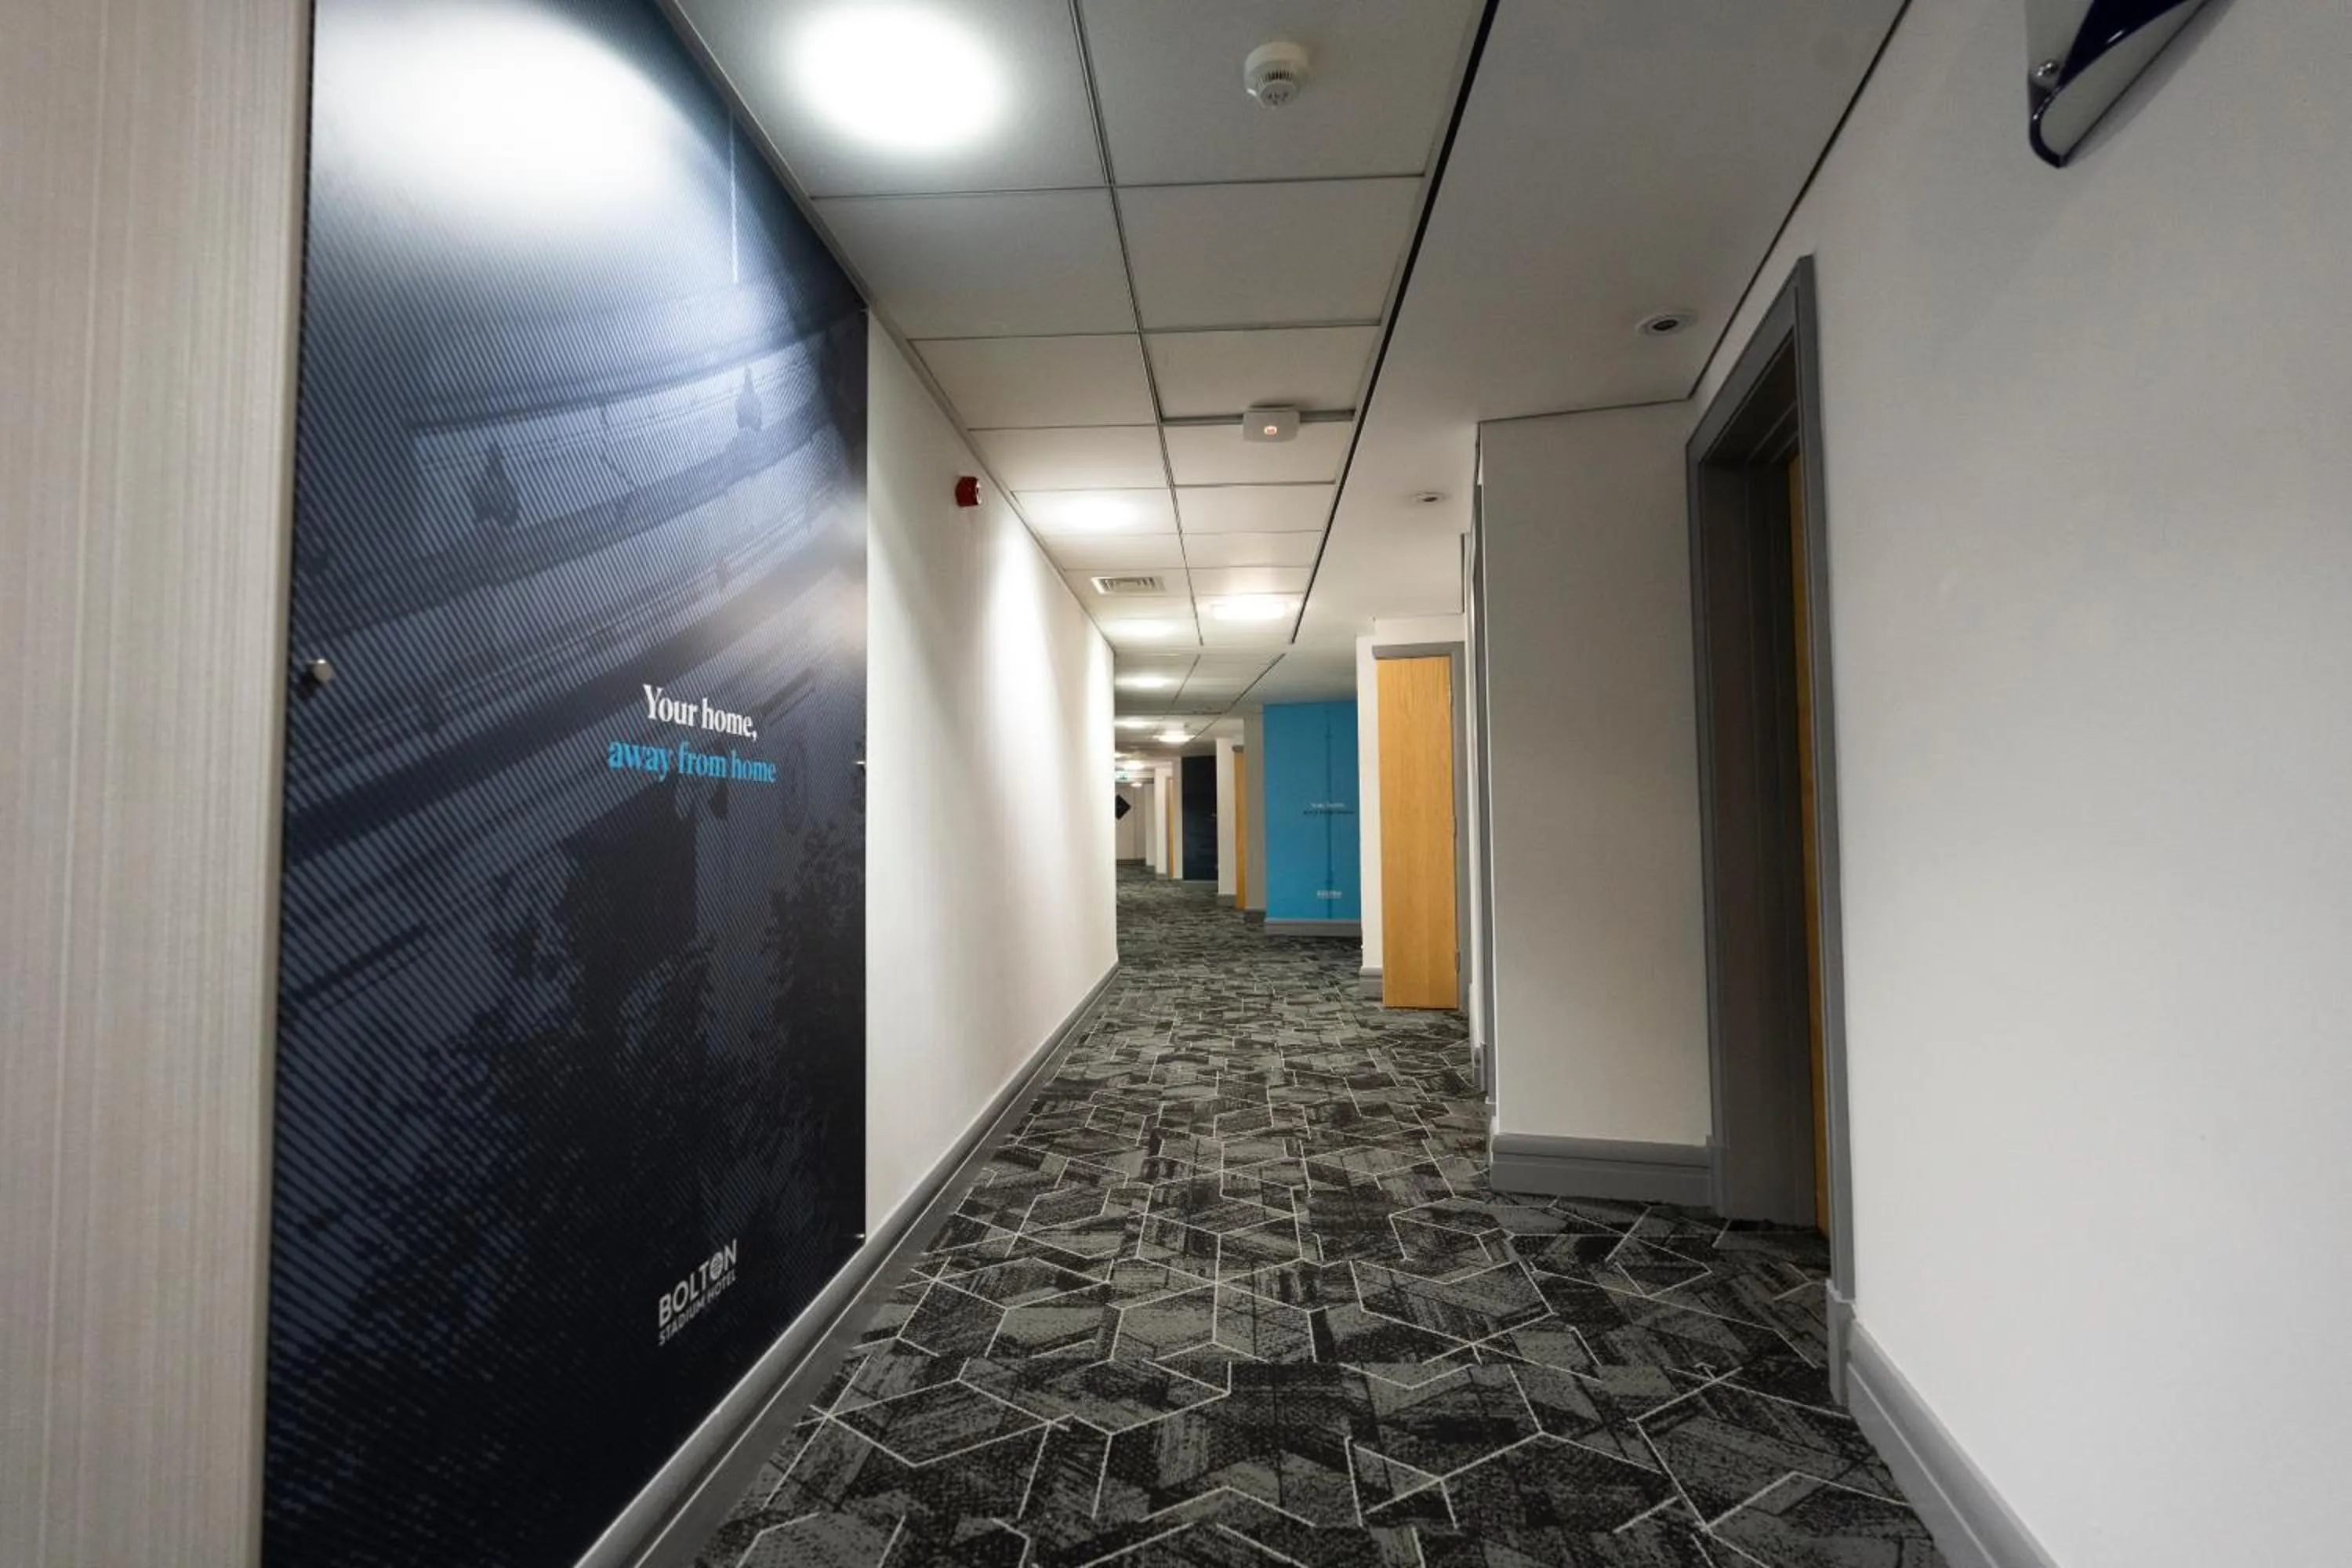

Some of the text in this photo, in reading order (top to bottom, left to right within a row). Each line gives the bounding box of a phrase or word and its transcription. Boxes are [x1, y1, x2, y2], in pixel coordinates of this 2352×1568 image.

[643, 683, 757, 741] Your home,
[608, 739, 776, 783] away from home
[659, 1238, 737, 1328] BOLTON
[659, 1269, 736, 1346] STADIUM HOTEL
